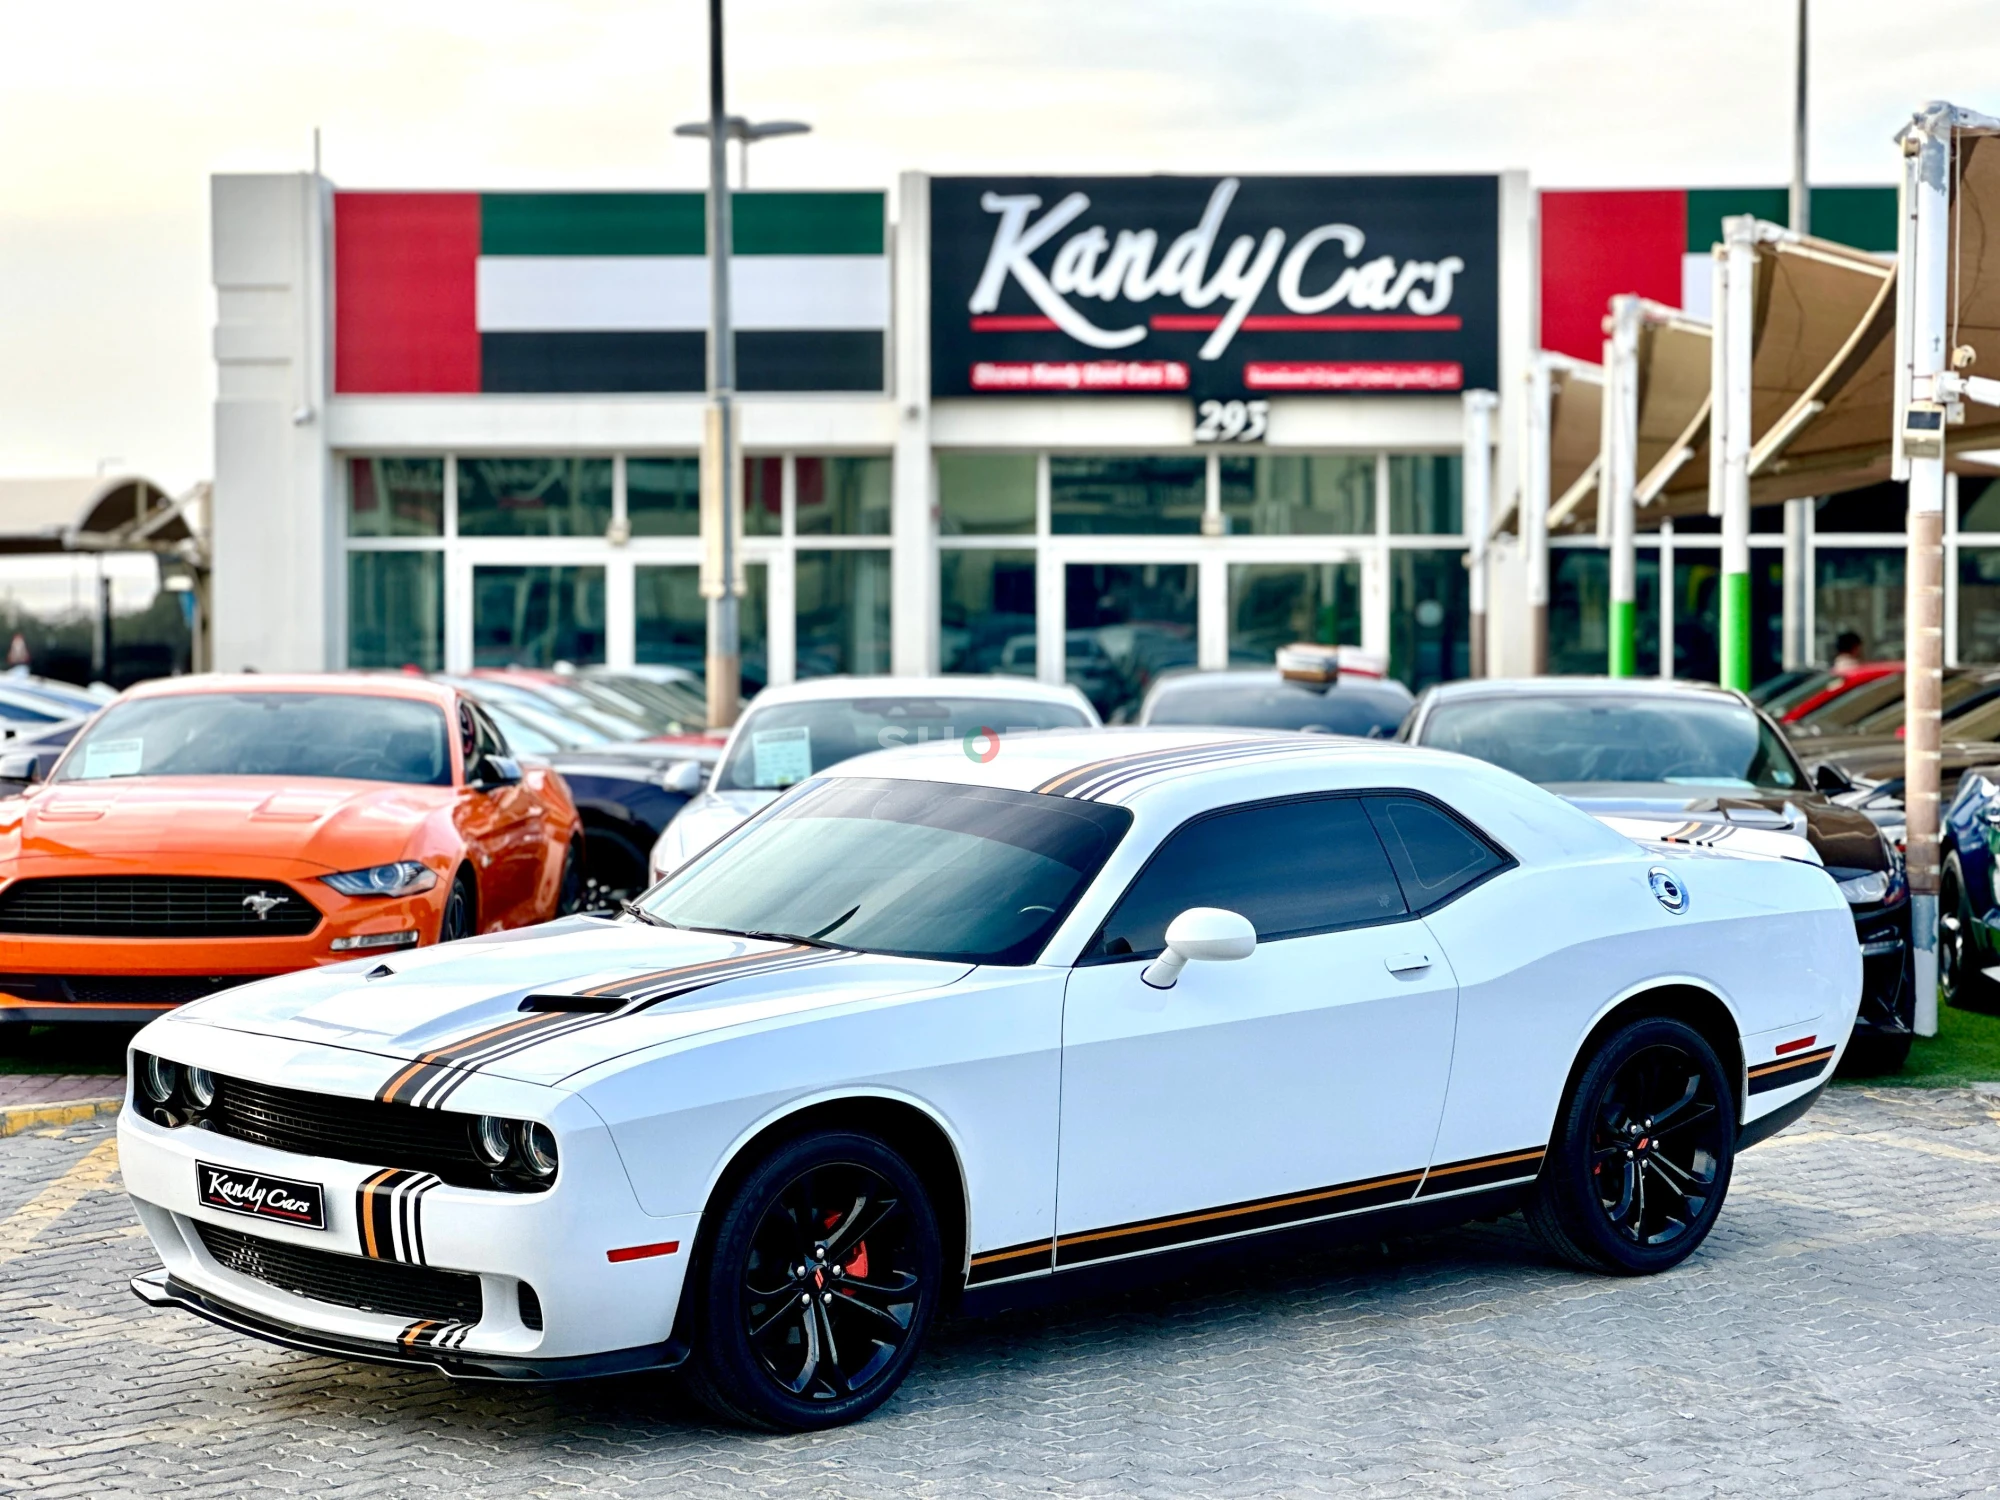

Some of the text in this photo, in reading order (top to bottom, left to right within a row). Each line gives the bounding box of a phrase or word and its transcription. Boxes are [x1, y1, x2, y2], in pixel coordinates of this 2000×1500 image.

[969, 177, 1464, 360] Kandy Cars
[1194, 399, 1270, 441] 295
[208, 1170, 310, 1213] Kandy Cars
